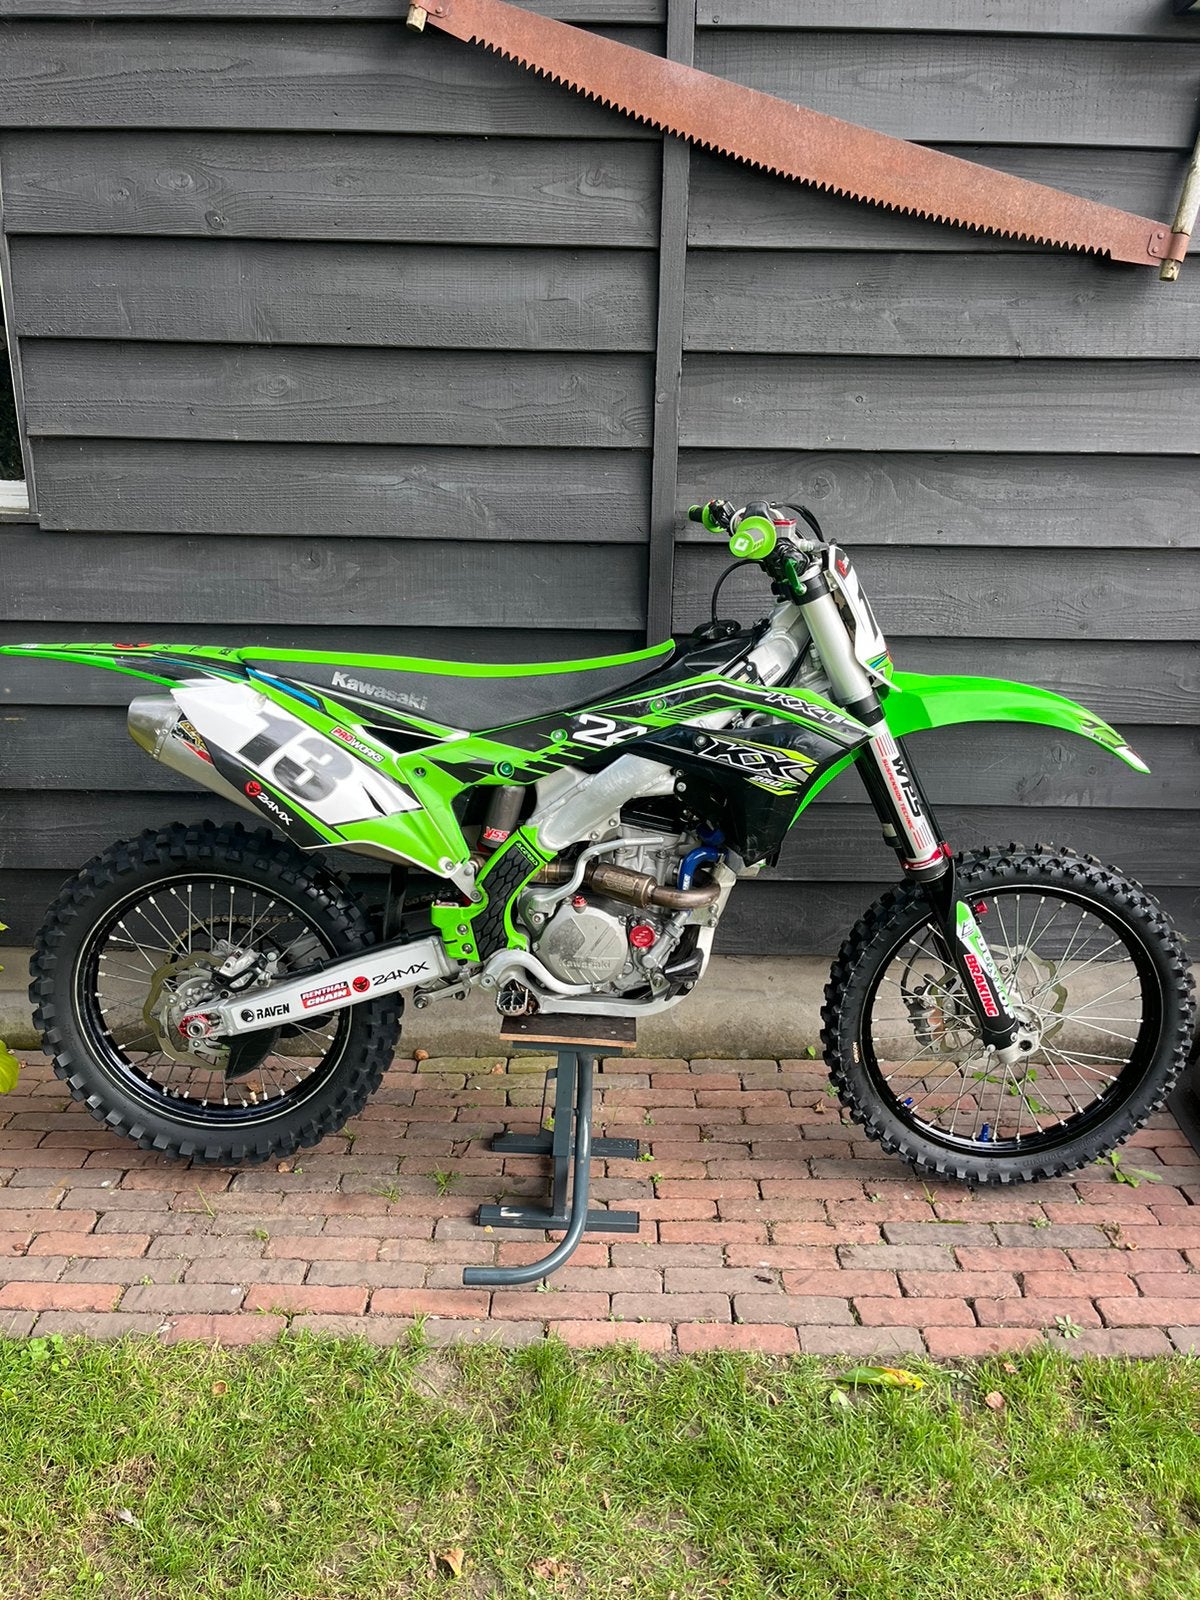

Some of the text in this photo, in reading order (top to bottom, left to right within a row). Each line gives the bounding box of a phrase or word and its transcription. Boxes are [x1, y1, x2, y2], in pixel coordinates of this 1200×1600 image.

[331, 671, 428, 711] Kawasaki
[236, 711, 354, 802] 13
[698, 736, 814, 783] KX
[882, 758, 903, 802] SUSPENSION
[892, 756, 921, 818] WPS
[256, 790, 294, 827] 24MX
[483, 825, 510, 842] YSS
[372, 961, 430, 987] 24MX
[559, 958, 611, 970] Kawasaki
[301, 982, 349, 1000] RENTHAL
[305, 989, 349, 1008] CHAIN
[963, 953, 1000, 1018] BRAKING
[256, 1003, 291, 1020] RAVEN
